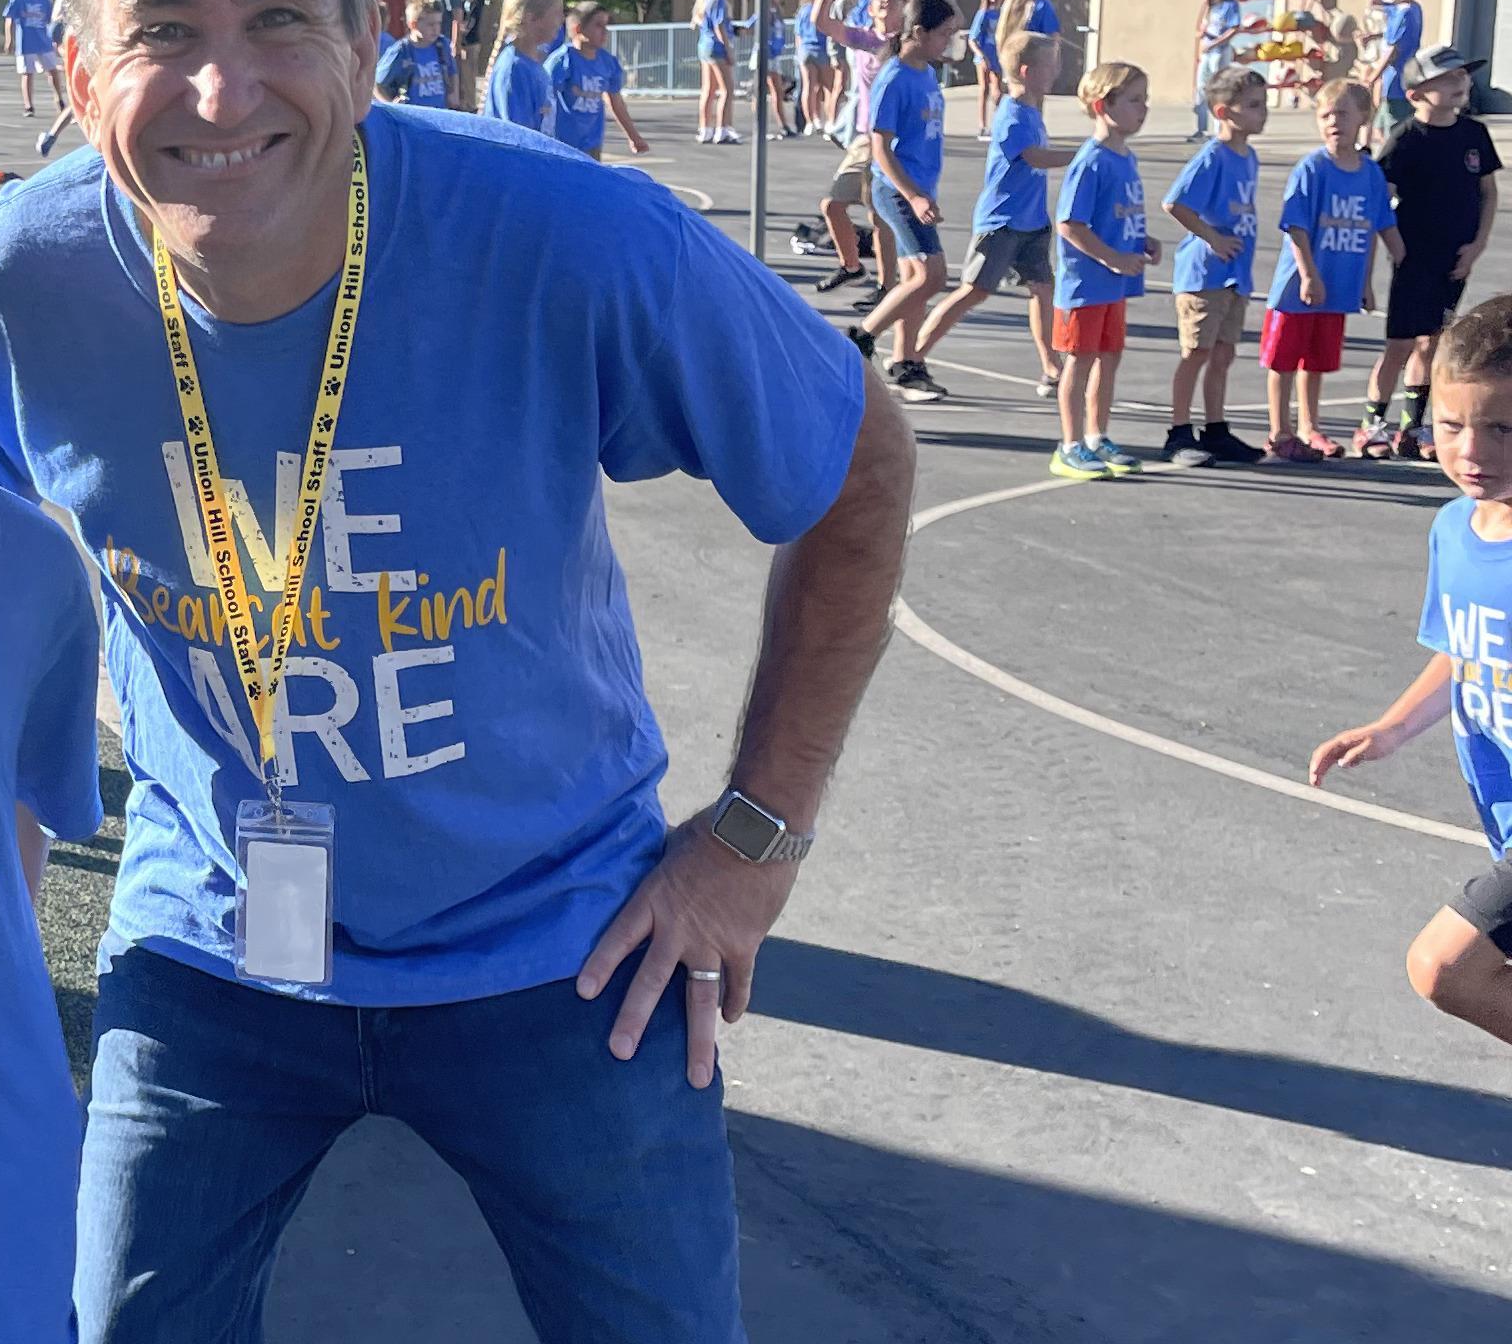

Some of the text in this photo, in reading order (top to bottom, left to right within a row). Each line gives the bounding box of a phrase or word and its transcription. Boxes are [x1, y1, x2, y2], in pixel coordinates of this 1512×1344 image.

[330, 134, 366, 369] Union Hill School Sta
[1320, 226, 1368, 253] ARE
[1332, 194, 1366, 221] WE
[156, 238, 189, 369] School Staff
[162, 441, 417, 592] WE
[194, 442, 256, 674] Union Hill School Staff
[273, 439, 328, 672] Union Hill School Staff
[378, 546, 507, 652] kind
[1442, 593, 1512, 671] WE
[188, 644, 466, 787] ARE
